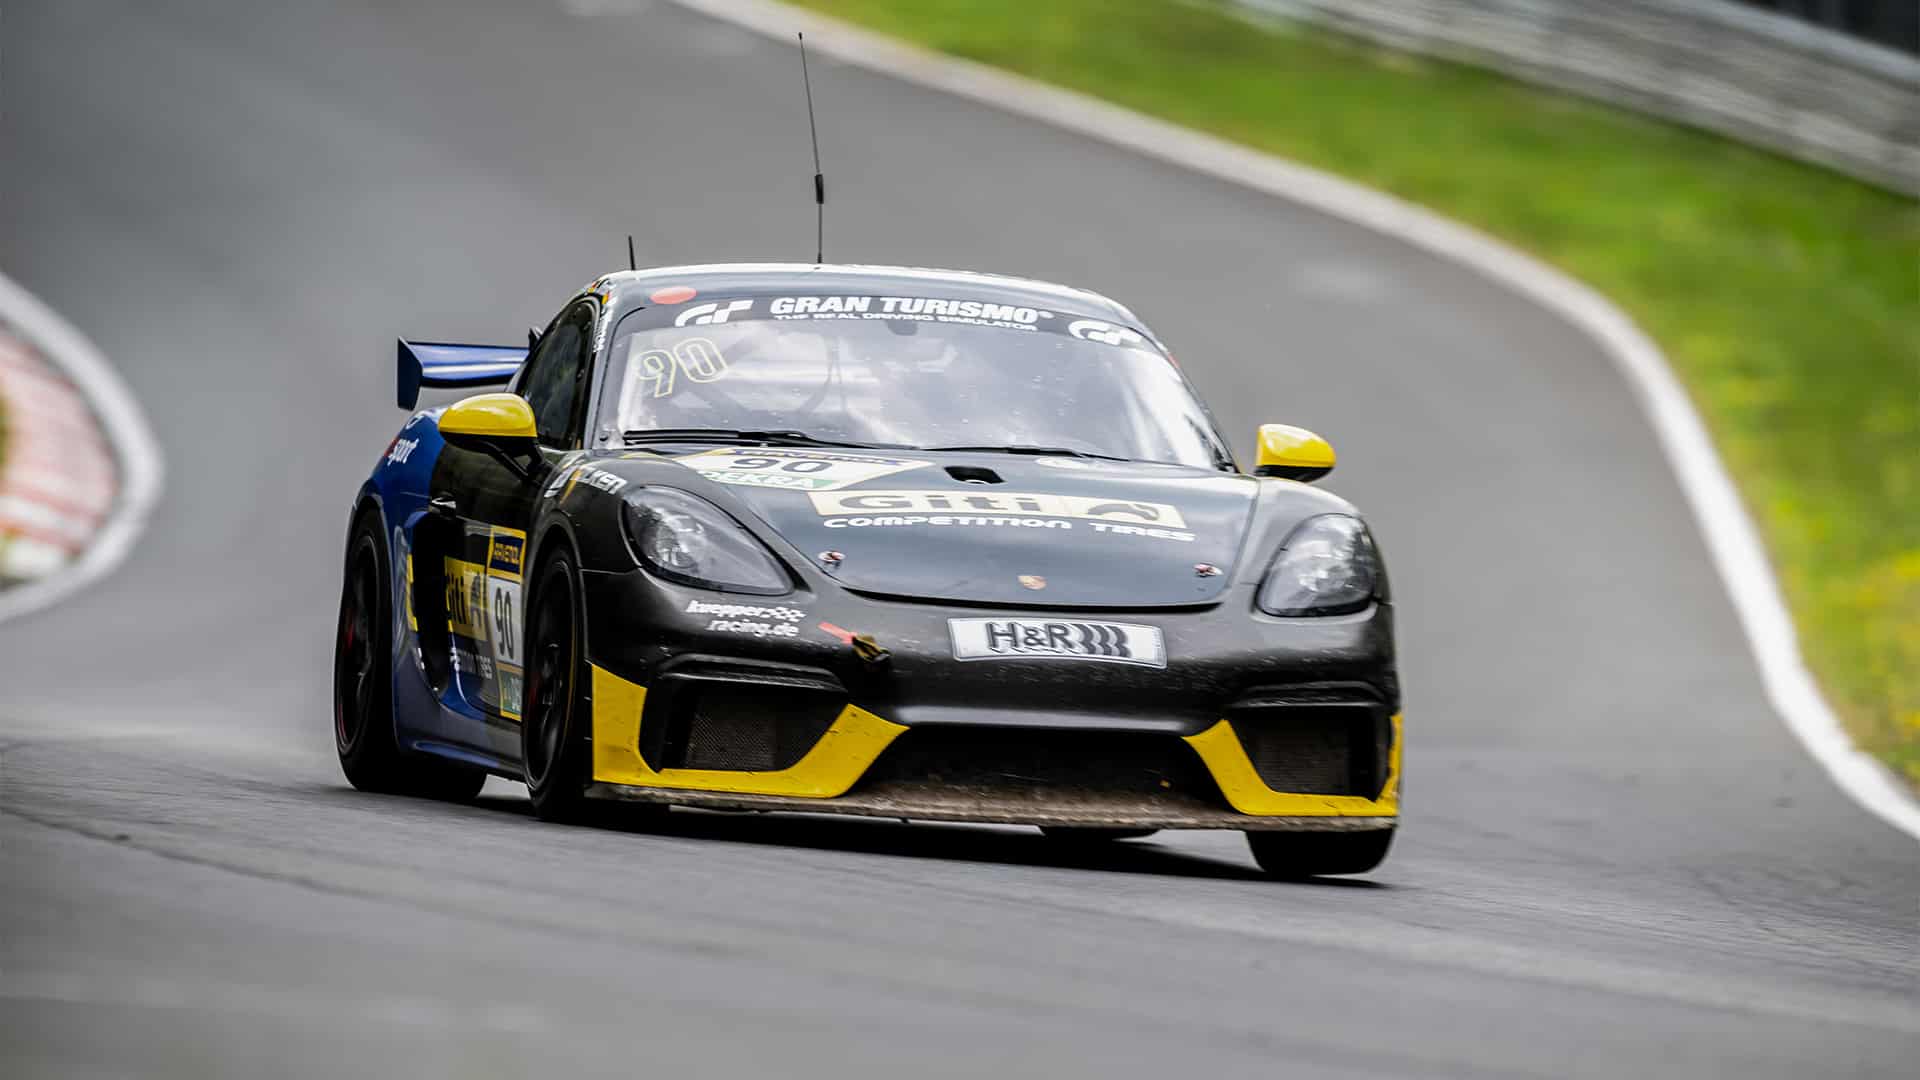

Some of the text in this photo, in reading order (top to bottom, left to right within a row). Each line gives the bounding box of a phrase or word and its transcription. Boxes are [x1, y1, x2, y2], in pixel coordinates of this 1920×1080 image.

[769, 296, 872, 315] GRAN
[773, 312, 1039, 331] THE REAL DRIVING SIMULATOR
[633, 337, 729, 398] 90
[730, 457, 833, 473] 90
[838, 494, 1042, 513] Giti
[823, 516, 1197, 542] COMPETITION TIRES
[494, 586, 515, 662] 90
[706, 618, 800, 637] racing.de
[985, 622, 1079, 655] H&R
